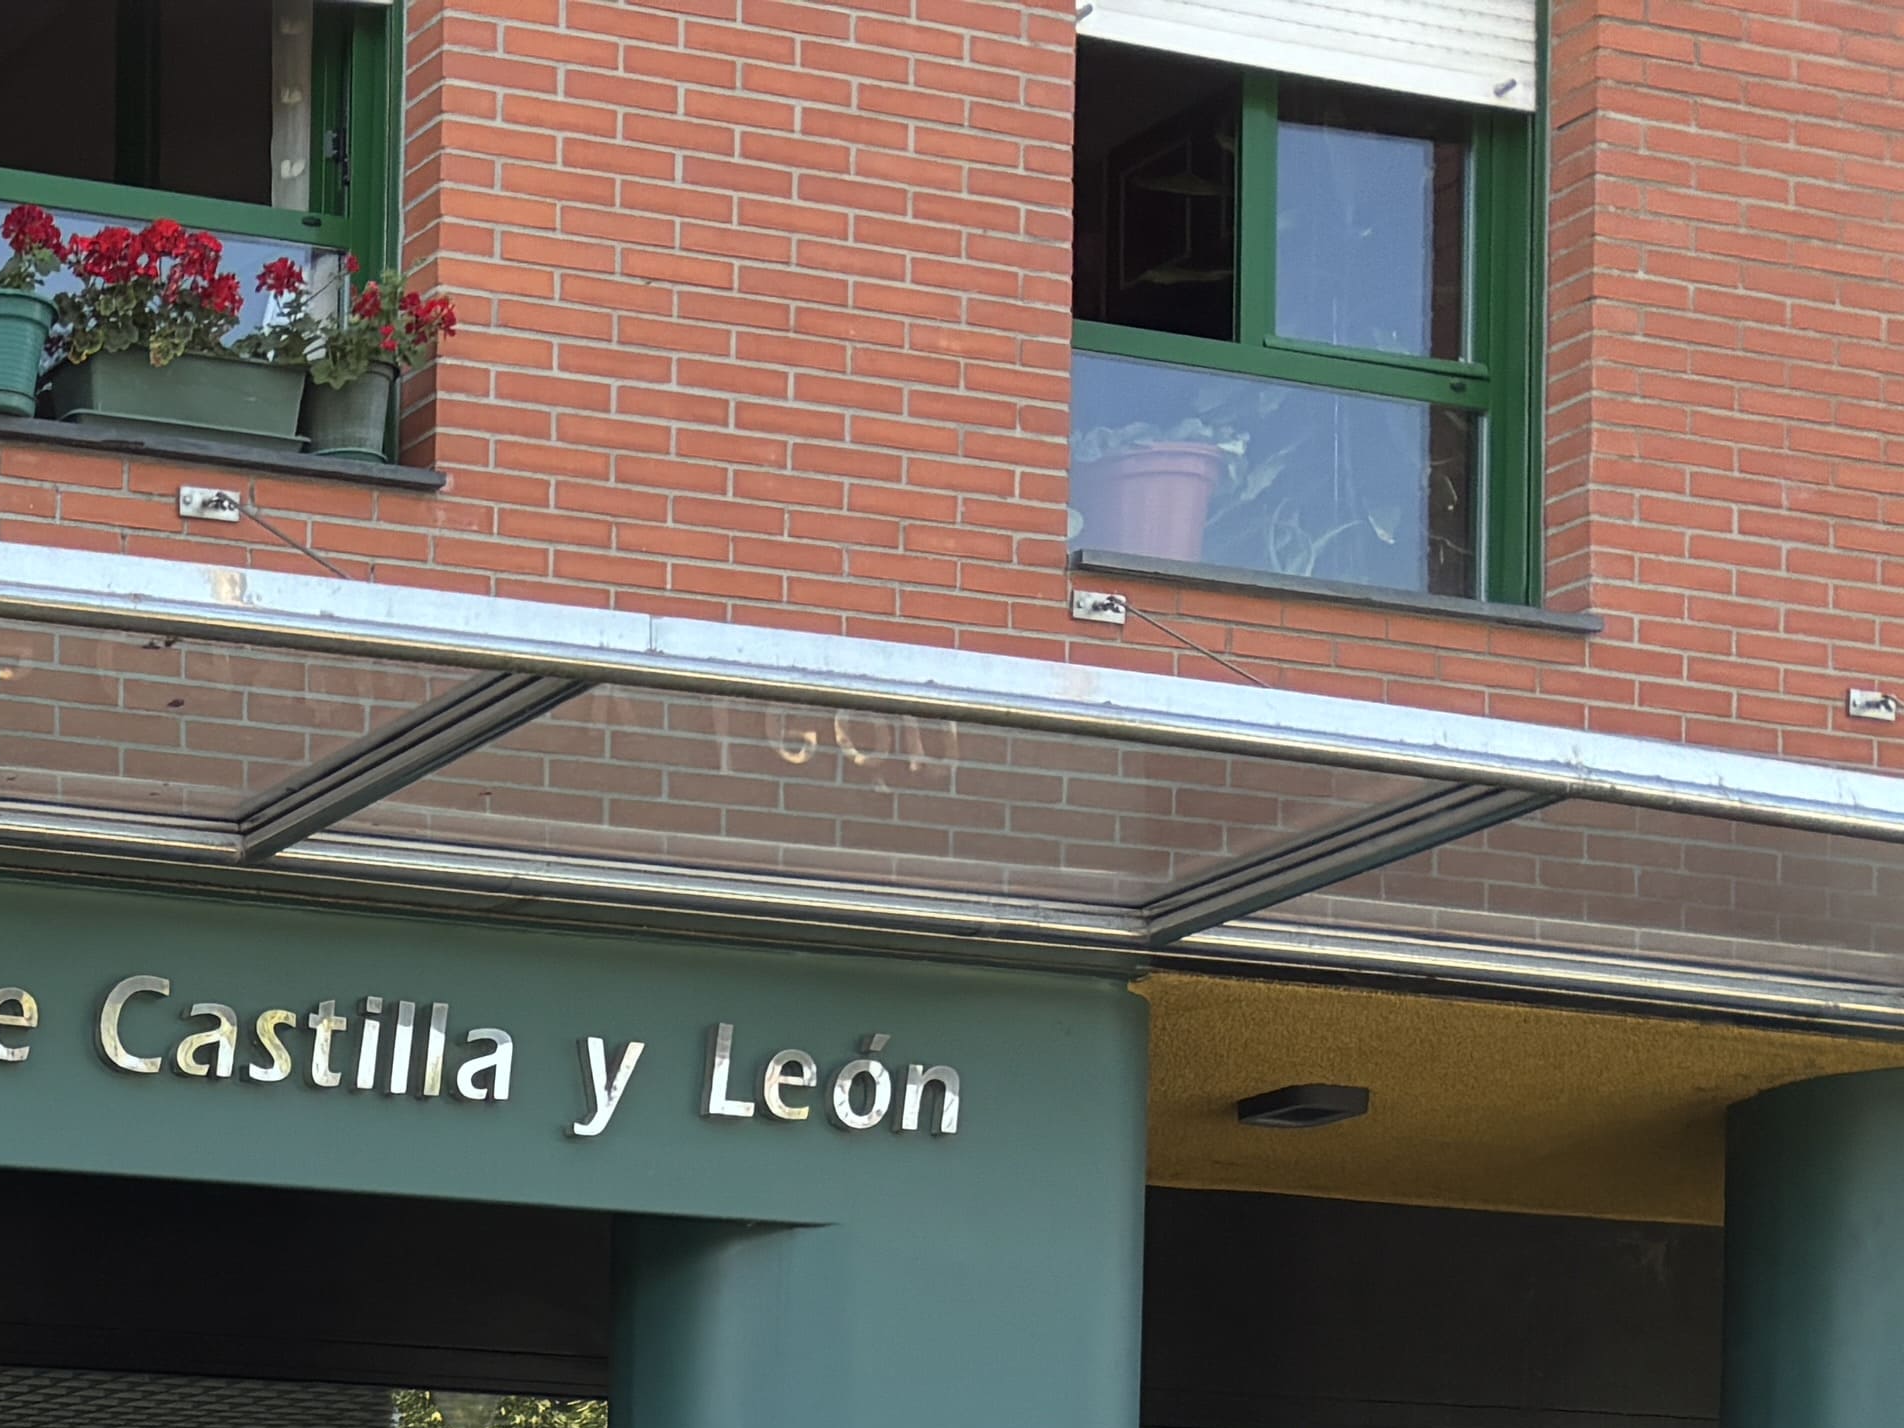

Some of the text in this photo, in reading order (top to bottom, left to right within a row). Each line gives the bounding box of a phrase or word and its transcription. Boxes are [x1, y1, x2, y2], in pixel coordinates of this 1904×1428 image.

[95, 972, 515, 1103] Castilla
[568, 1035, 646, 1138] y
[701, 1021, 964, 1136] León
